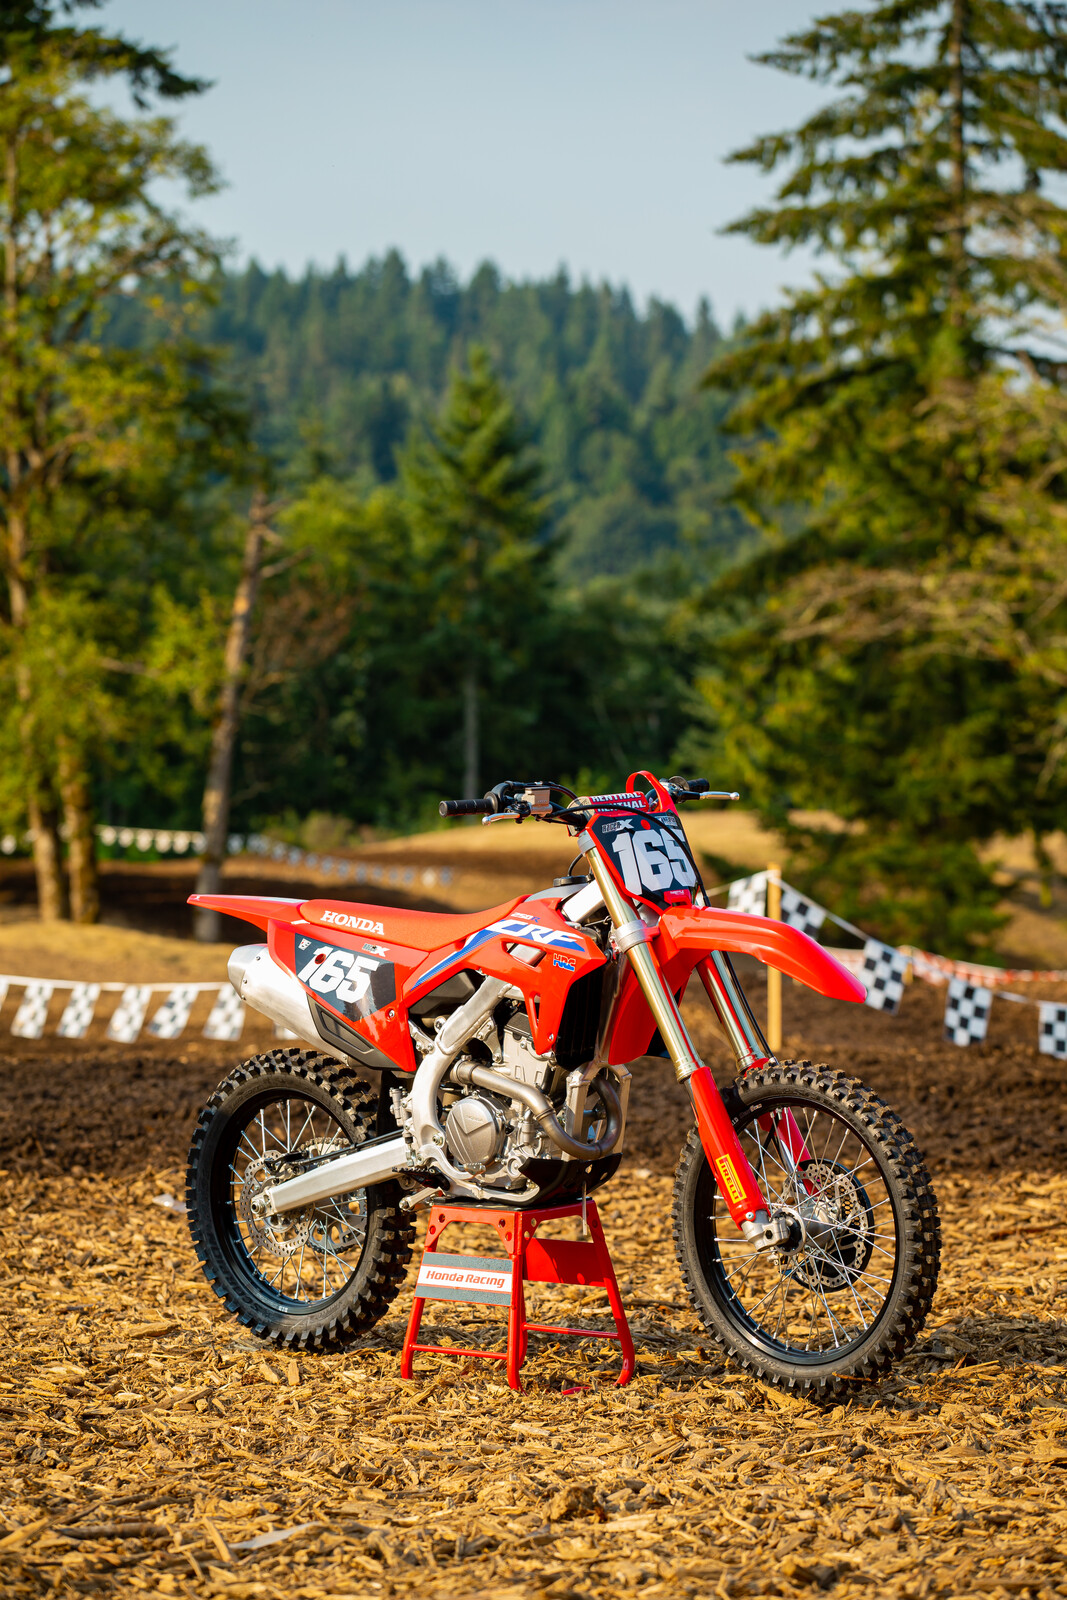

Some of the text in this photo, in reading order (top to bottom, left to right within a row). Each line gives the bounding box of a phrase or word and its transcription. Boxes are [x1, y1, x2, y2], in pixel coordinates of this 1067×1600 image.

[590, 792, 642, 803] RENTHAL
[612, 828, 696, 895] 165
[320, 910, 384, 935] HONDA
[485, 919, 584, 944] CRF
[297, 946, 380, 1003] 165
[719, 1157, 743, 1199] PIRELLI
[426, 1270, 505, 1288] Honda Racing
